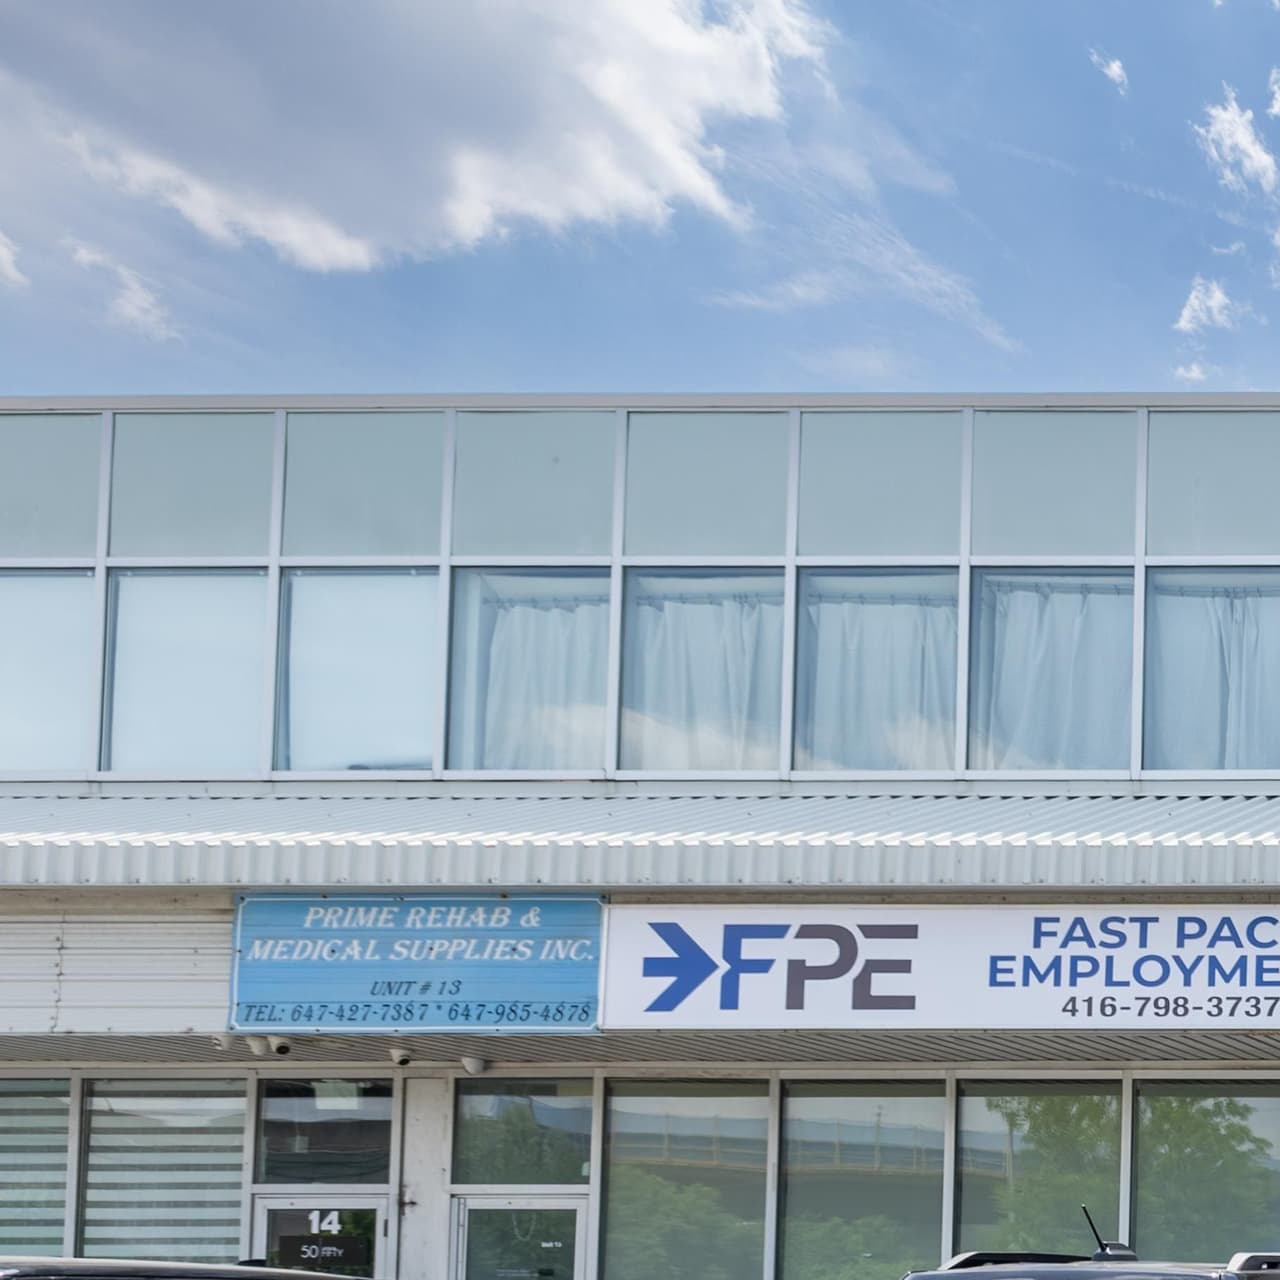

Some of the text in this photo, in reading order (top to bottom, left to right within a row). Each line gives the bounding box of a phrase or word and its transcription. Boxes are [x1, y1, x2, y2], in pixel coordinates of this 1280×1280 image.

[303, 906, 541, 929] PRIME REHAB &
[1031, 916, 1159, 949] FAST
[247, 939, 594, 961] MEDICAL SUPPLIES INC.
[720, 923, 919, 1012] FPE
[370, 981, 416, 996] UNIT
[419, 981, 432, 995] #
[243, 1005, 285, 1022] TEL:
[448, 1001, 591, 1024] 647-985-4878
[1062, 995, 1280, 1018] 416-798-3737
[308, 1210, 342, 1234] 14
[300, 1245, 319, 1259] 50
